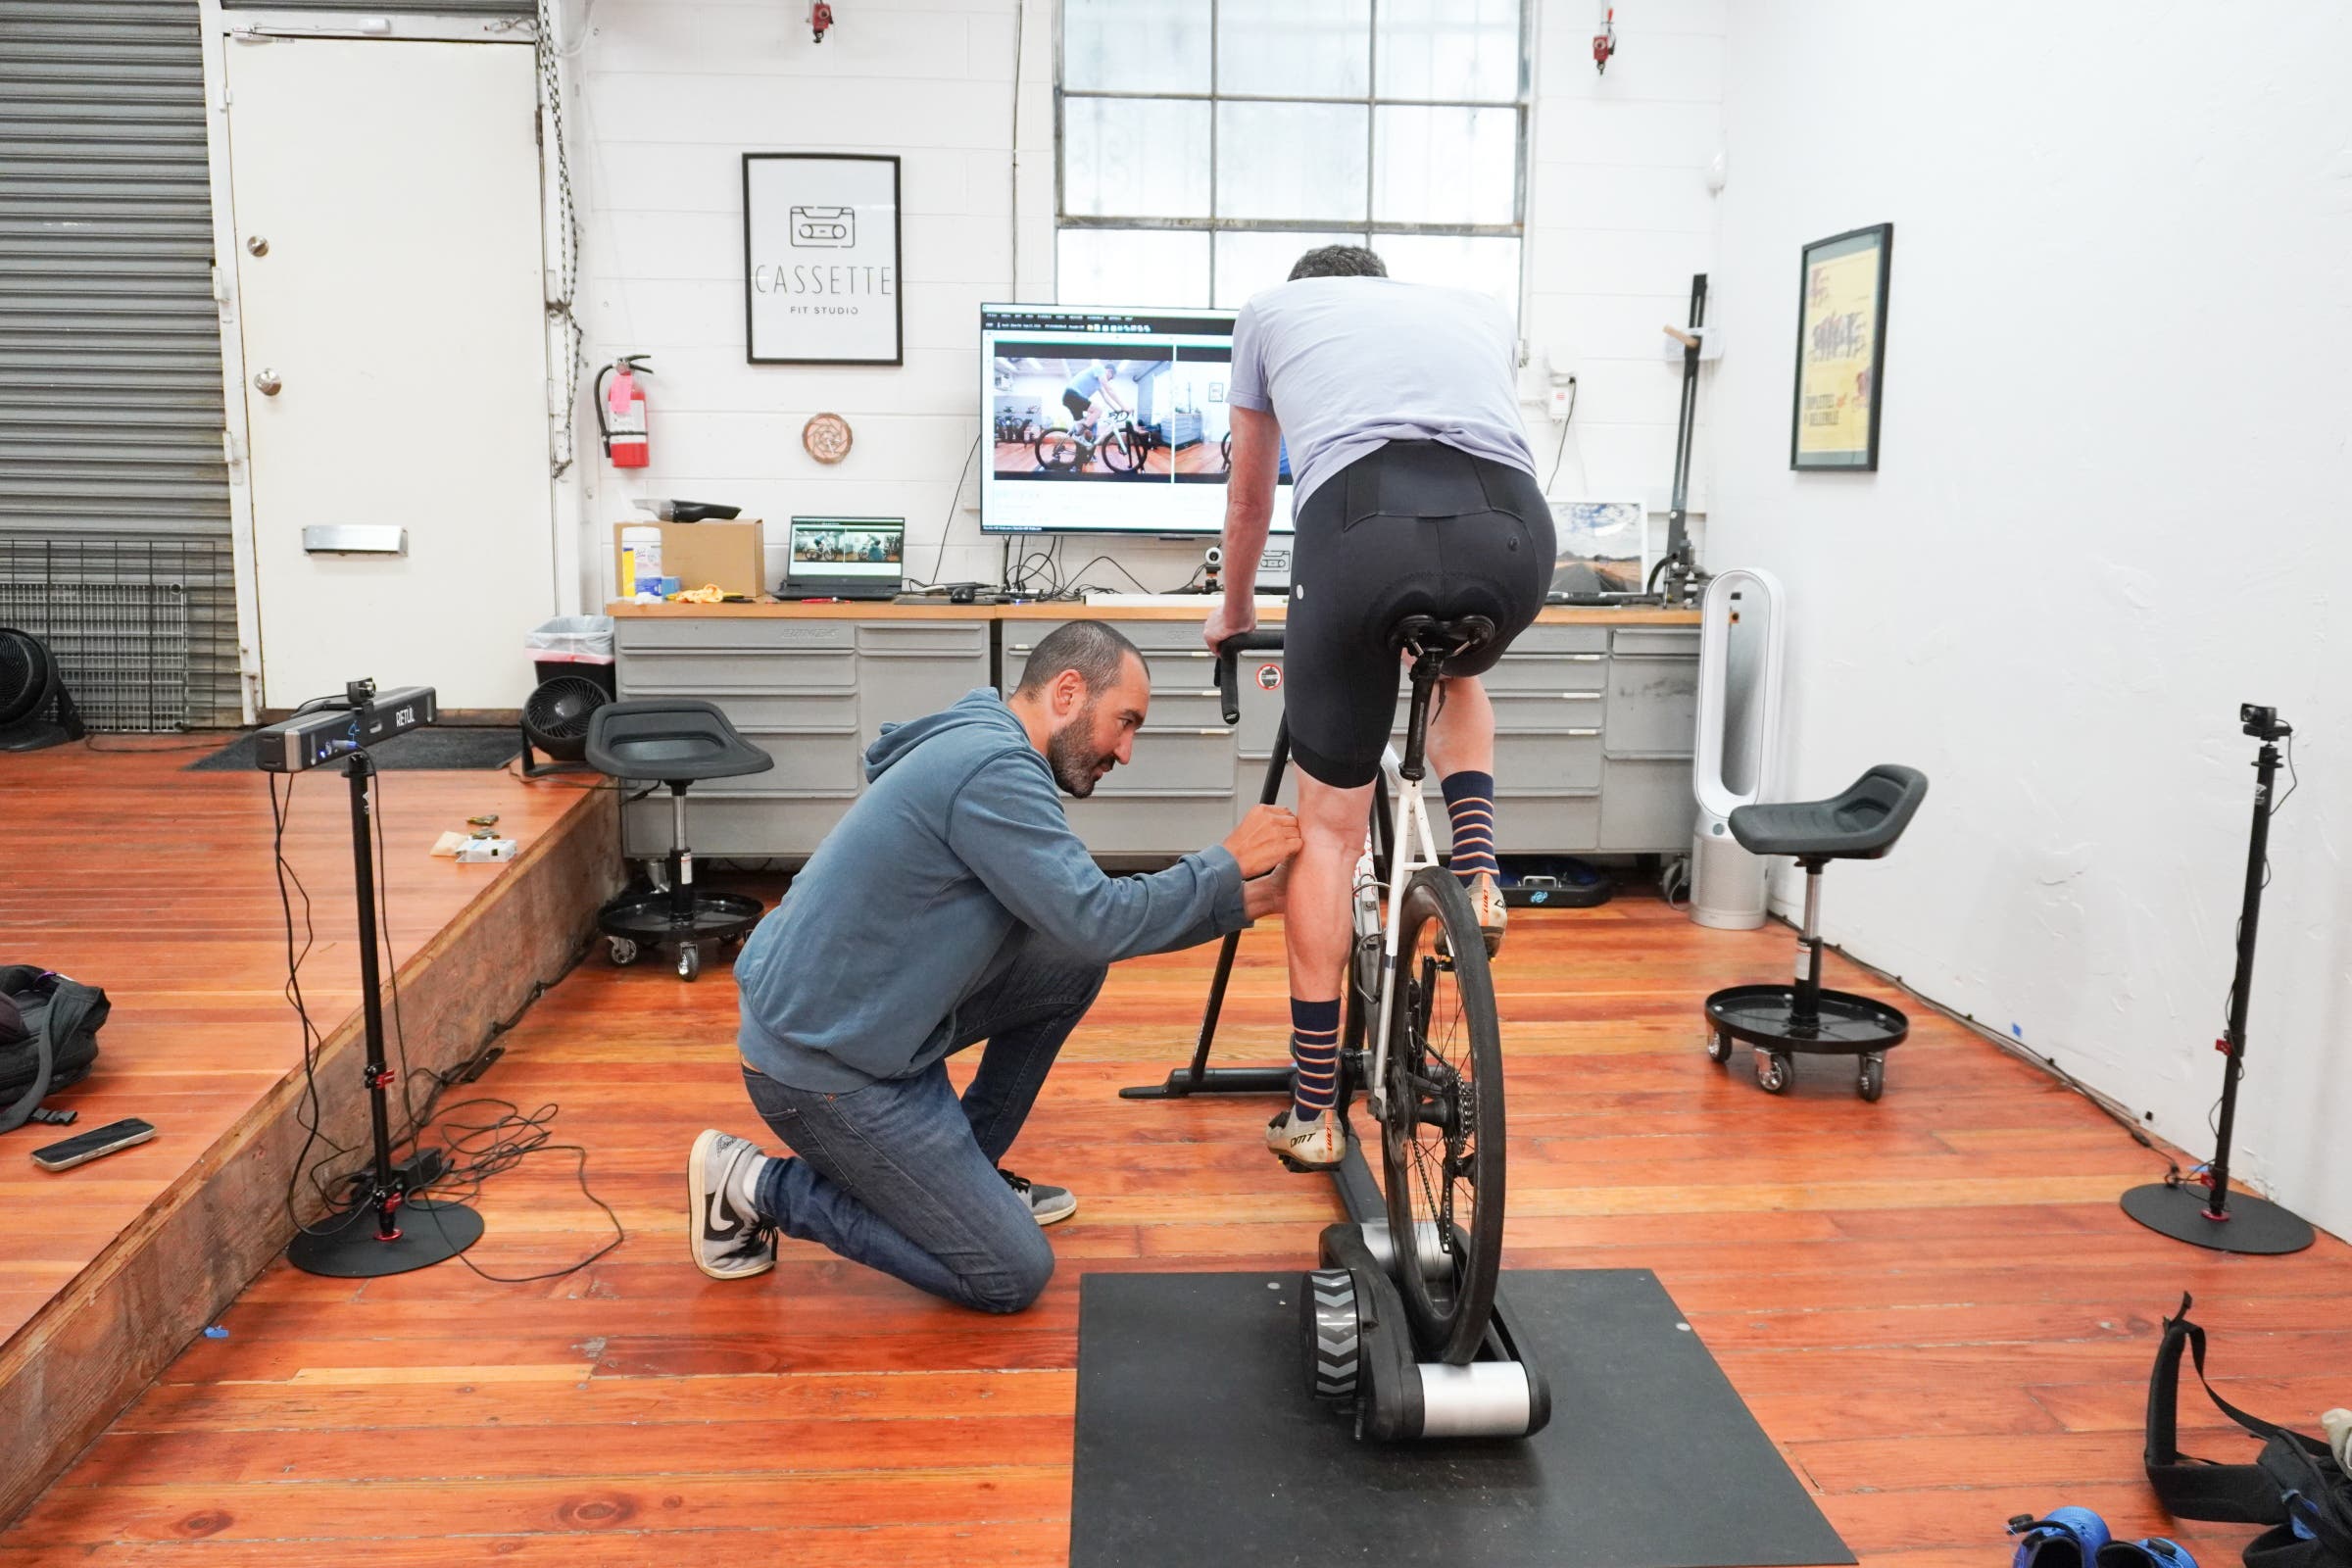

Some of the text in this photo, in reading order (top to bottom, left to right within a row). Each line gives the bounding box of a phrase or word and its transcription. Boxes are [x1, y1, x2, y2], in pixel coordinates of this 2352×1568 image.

[755, 265, 892, 295] CASSETTE
[790, 306, 859, 315] FIT STUDIO
[1290, 1132, 1316, 1149] DMT
